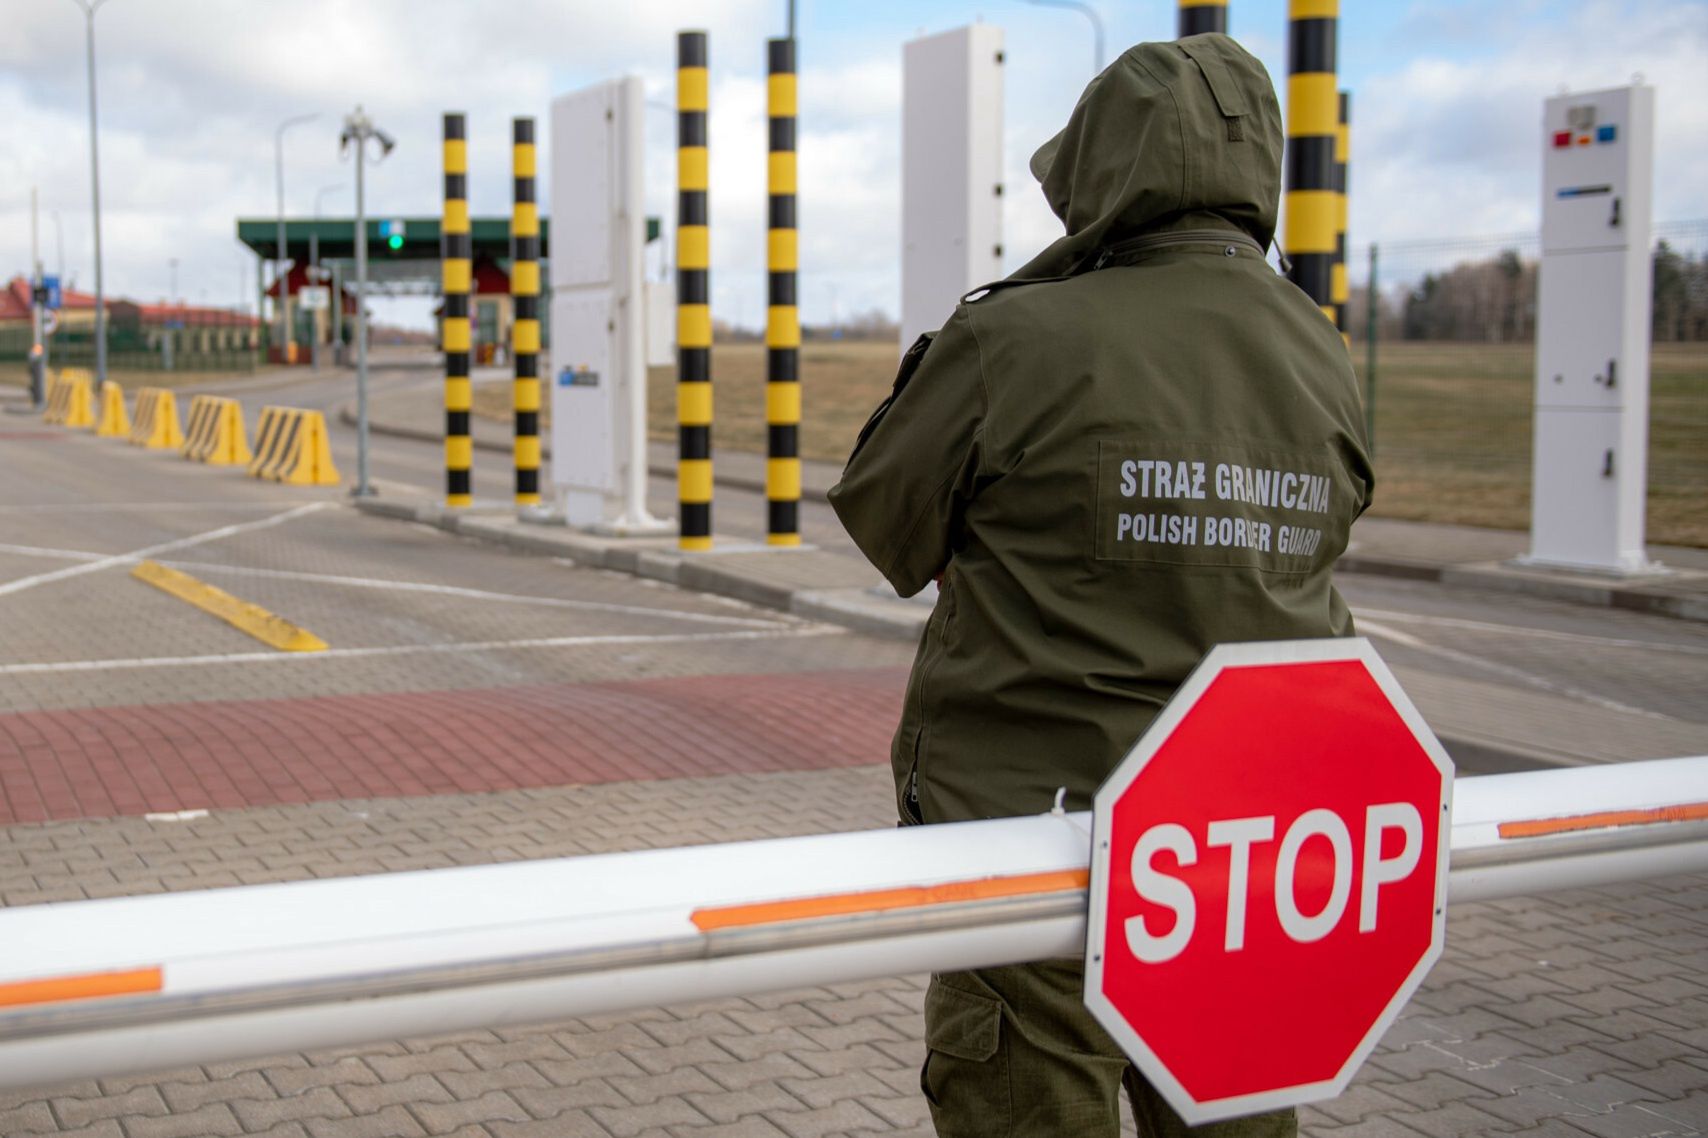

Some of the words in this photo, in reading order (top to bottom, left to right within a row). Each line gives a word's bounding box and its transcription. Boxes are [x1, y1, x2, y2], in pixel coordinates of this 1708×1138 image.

[1215, 463, 1331, 514] GRANICZNA
[1117, 513, 1197, 545] POLISH
[1204, 516, 1272, 553] BORDER
[1277, 525, 1322, 557] GUARD
[1124, 801, 1424, 964] STOP
